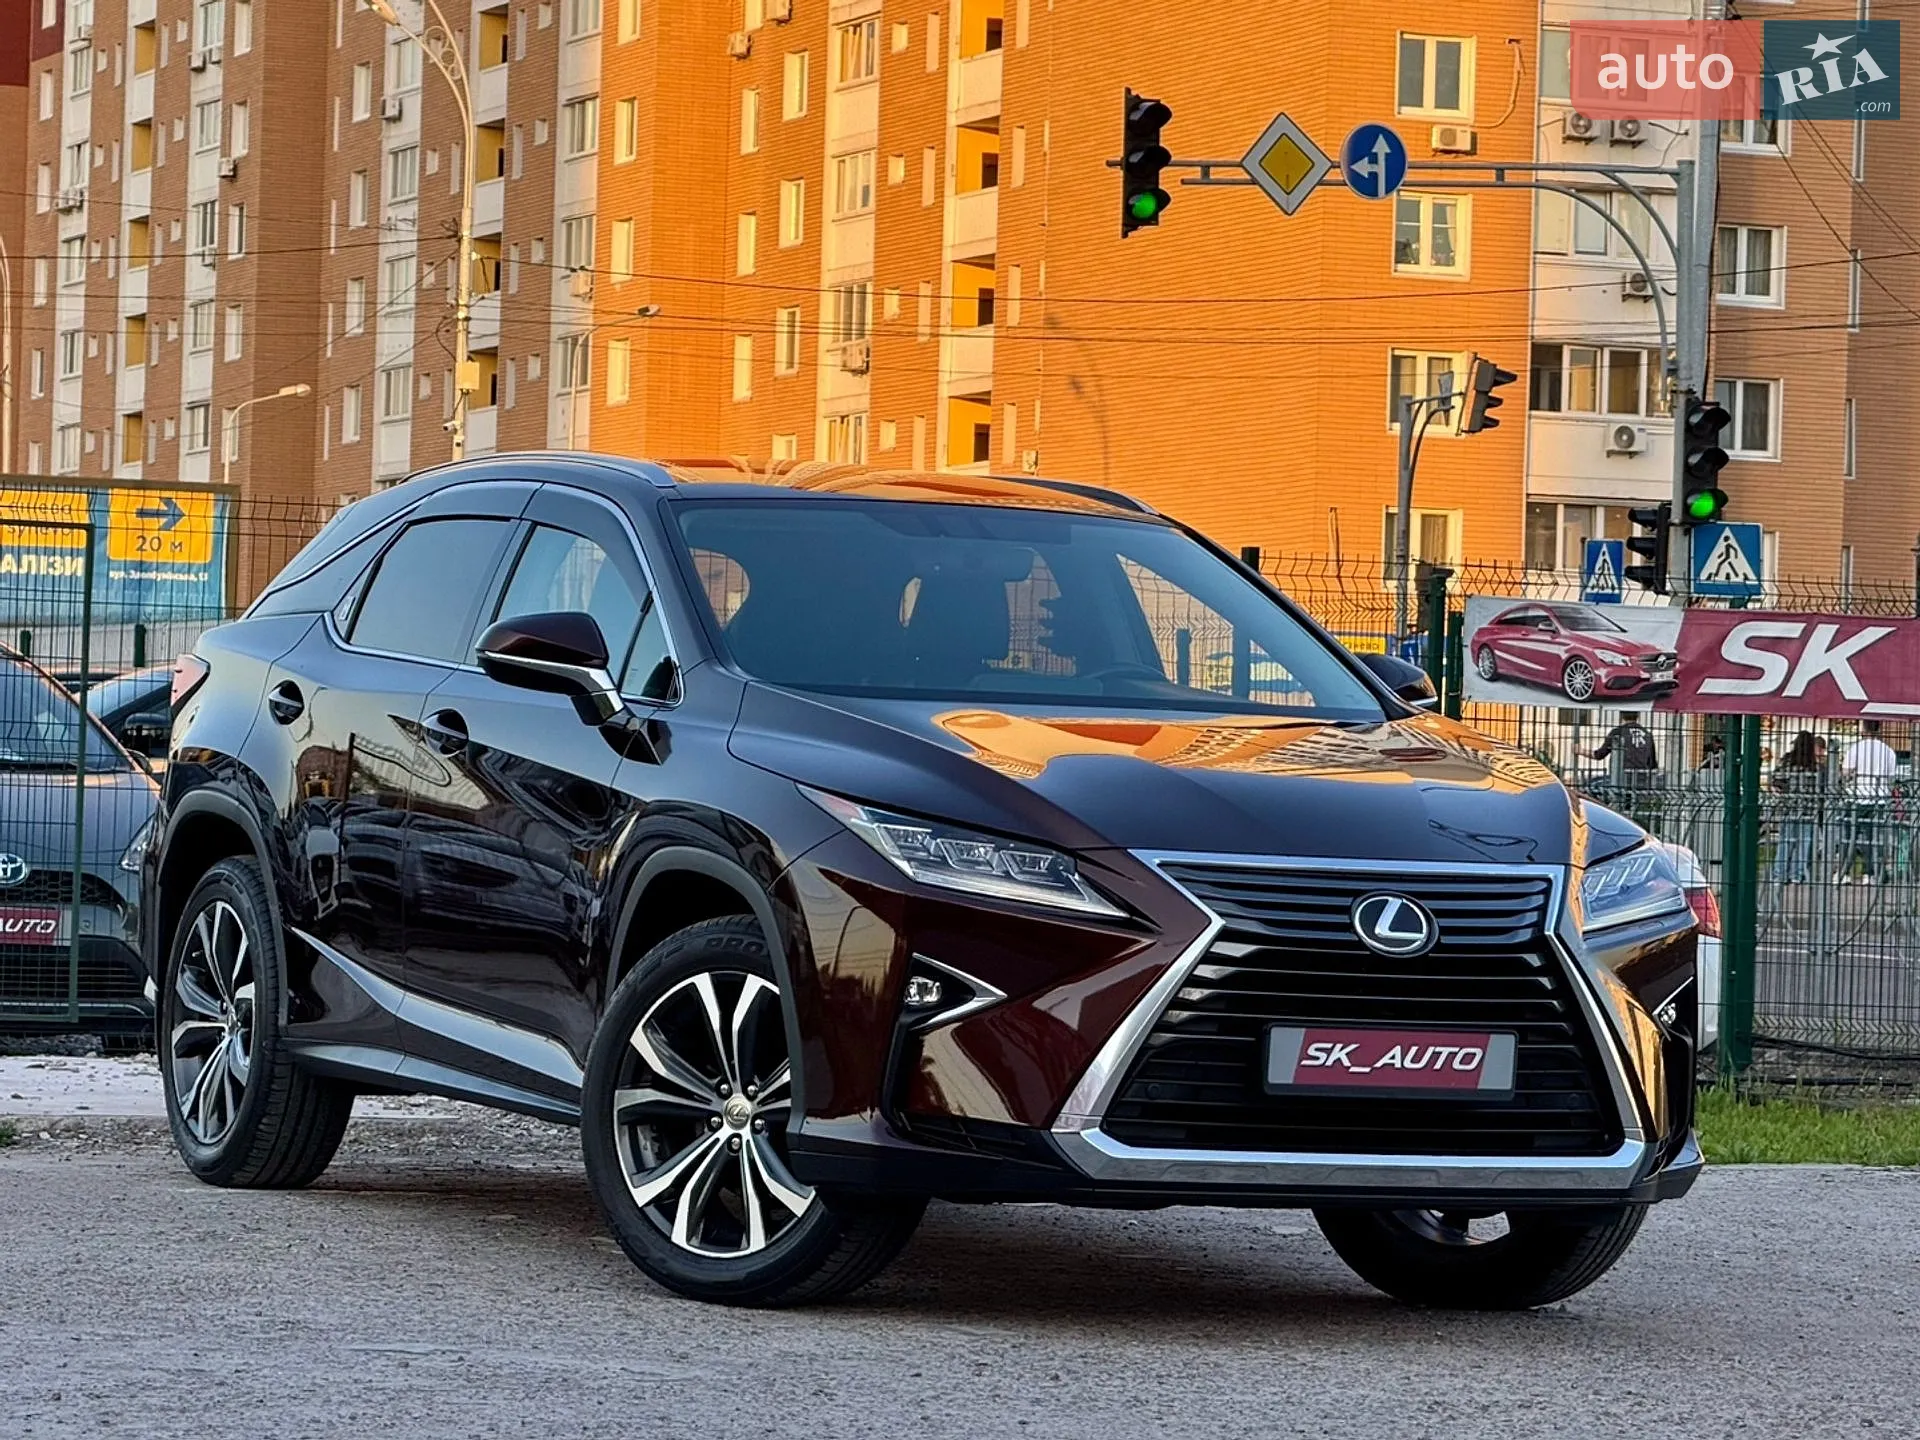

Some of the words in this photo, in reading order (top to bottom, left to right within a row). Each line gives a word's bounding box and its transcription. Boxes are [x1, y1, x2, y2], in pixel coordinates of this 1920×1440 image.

[135, 535, 162, 552] 20
[0, 918, 57, 934] UTO
[1301, 1042, 1483, 1073] SK_AUTO
